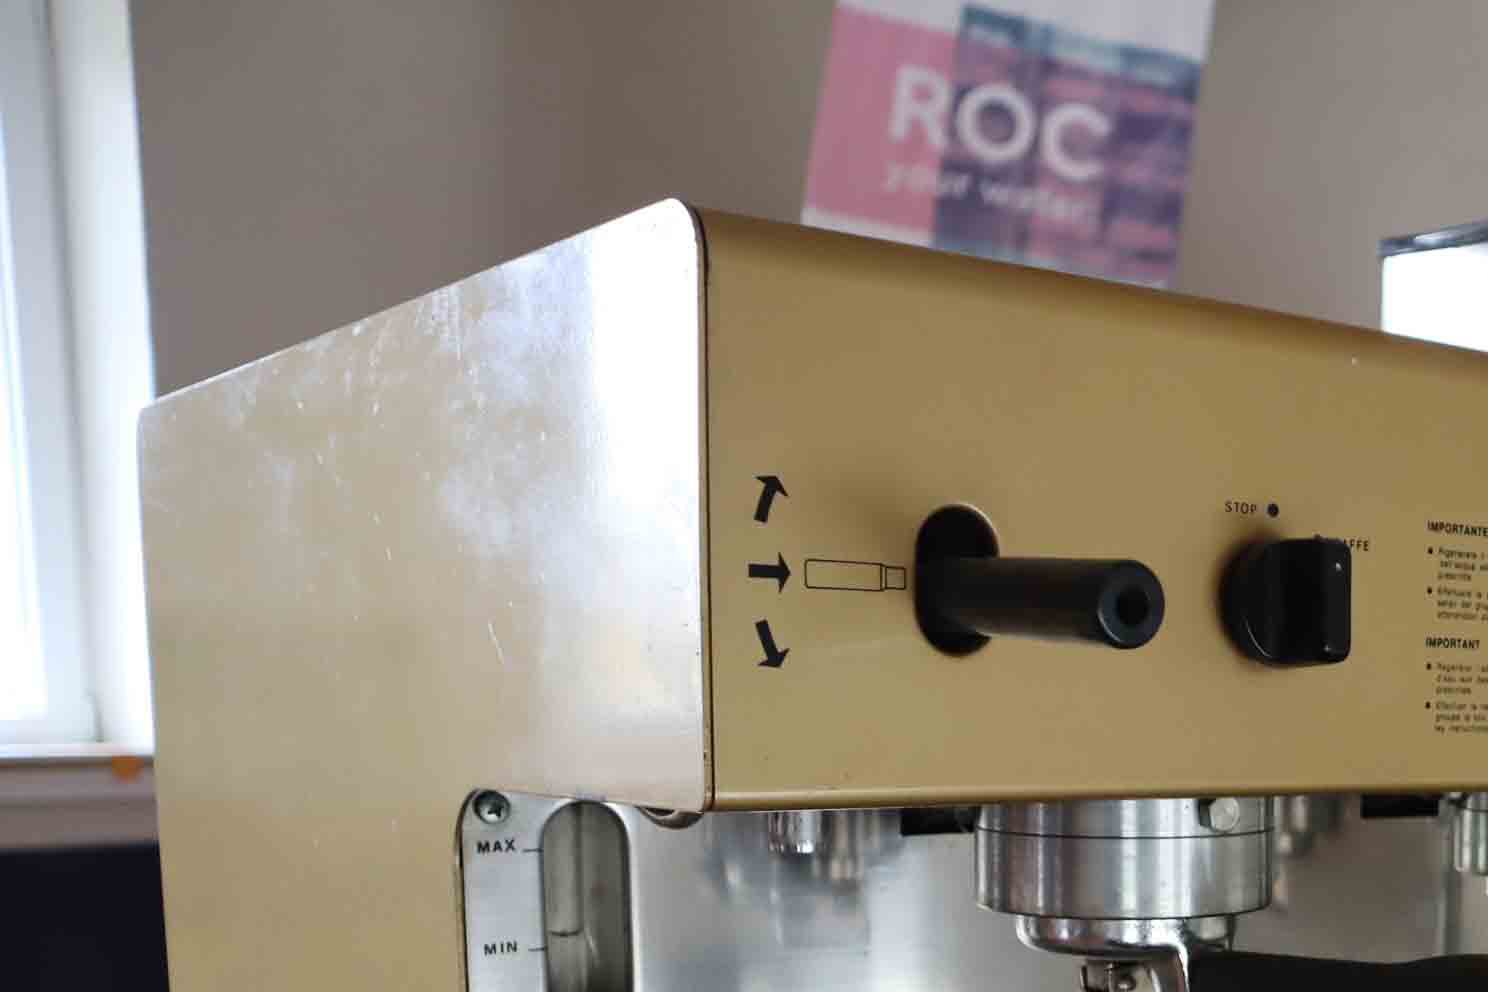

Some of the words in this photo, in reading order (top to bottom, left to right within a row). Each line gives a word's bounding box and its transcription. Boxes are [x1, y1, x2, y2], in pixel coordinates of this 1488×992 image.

[888, 64, 1110, 184] ROC
[1224, 501, 1257, 515] STOP
[1427, 519, 1488, 538] IMPORTANTE
[1425, 637, 1480, 649] IMPORTANT
[476, 838, 516, 854] MAX
[484, 941, 518, 956] MIN
